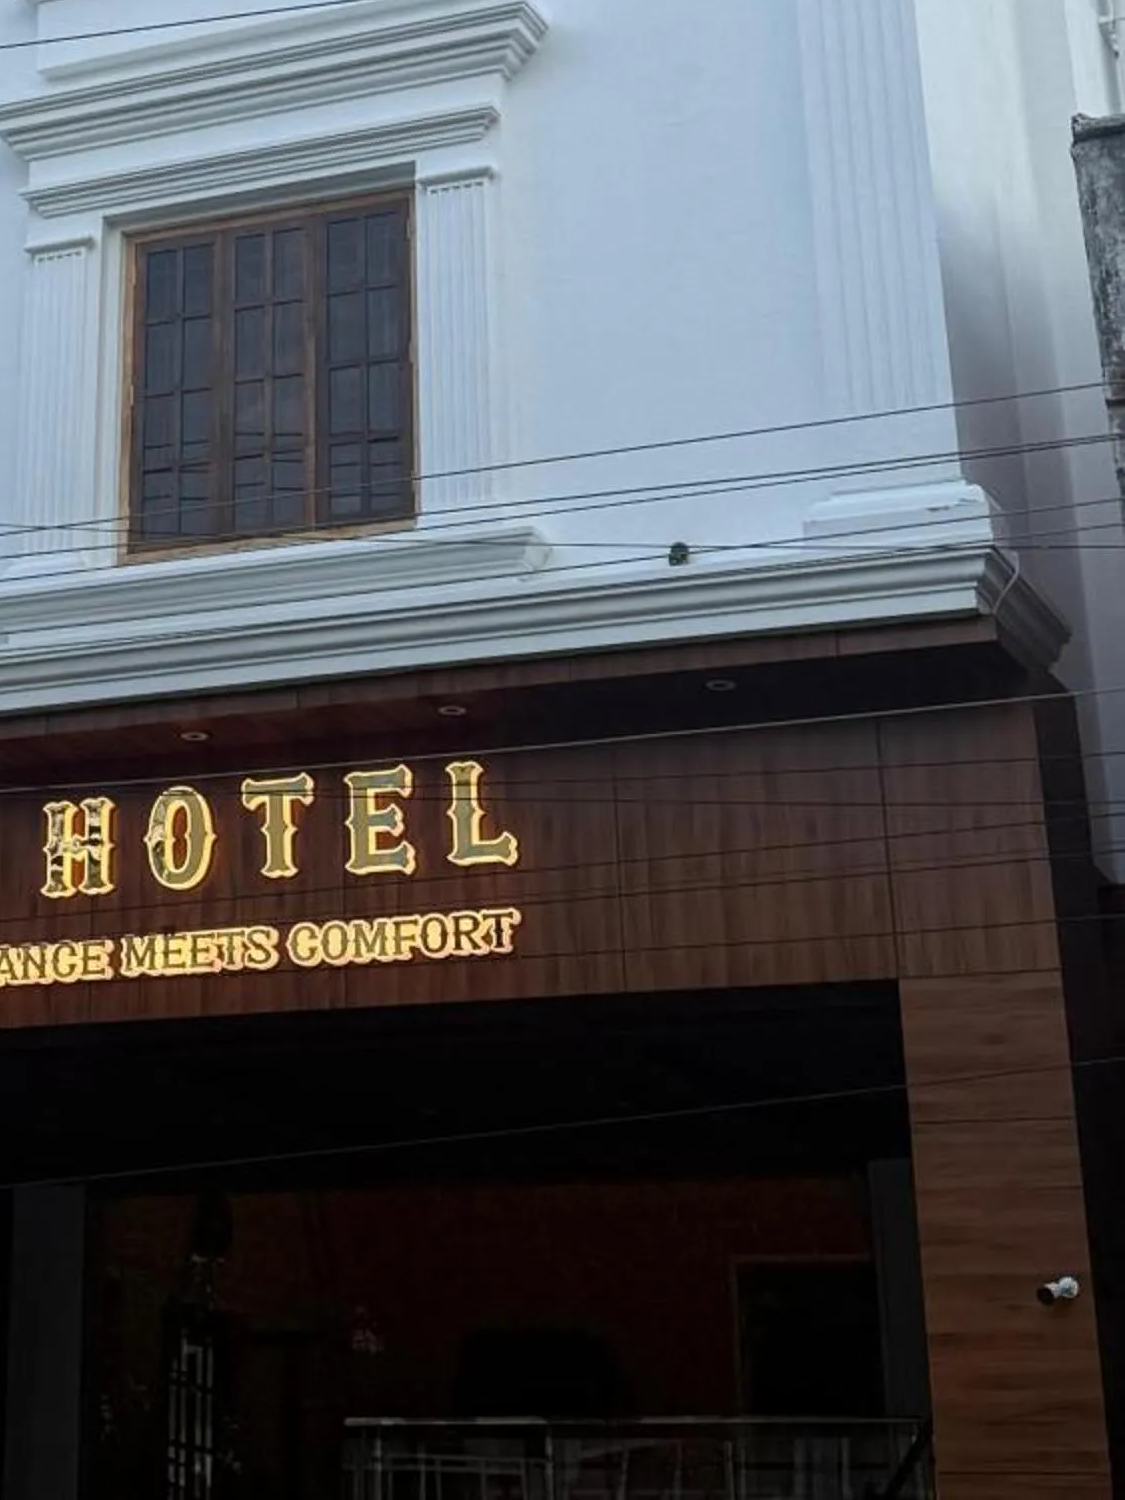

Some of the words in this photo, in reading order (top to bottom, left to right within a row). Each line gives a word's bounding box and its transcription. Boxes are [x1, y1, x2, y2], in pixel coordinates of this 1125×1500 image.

[41, 761, 518, 898] HOTEL
[121, 926, 278, 978] MEETS
[286, 908, 521, 967] COMFORT
